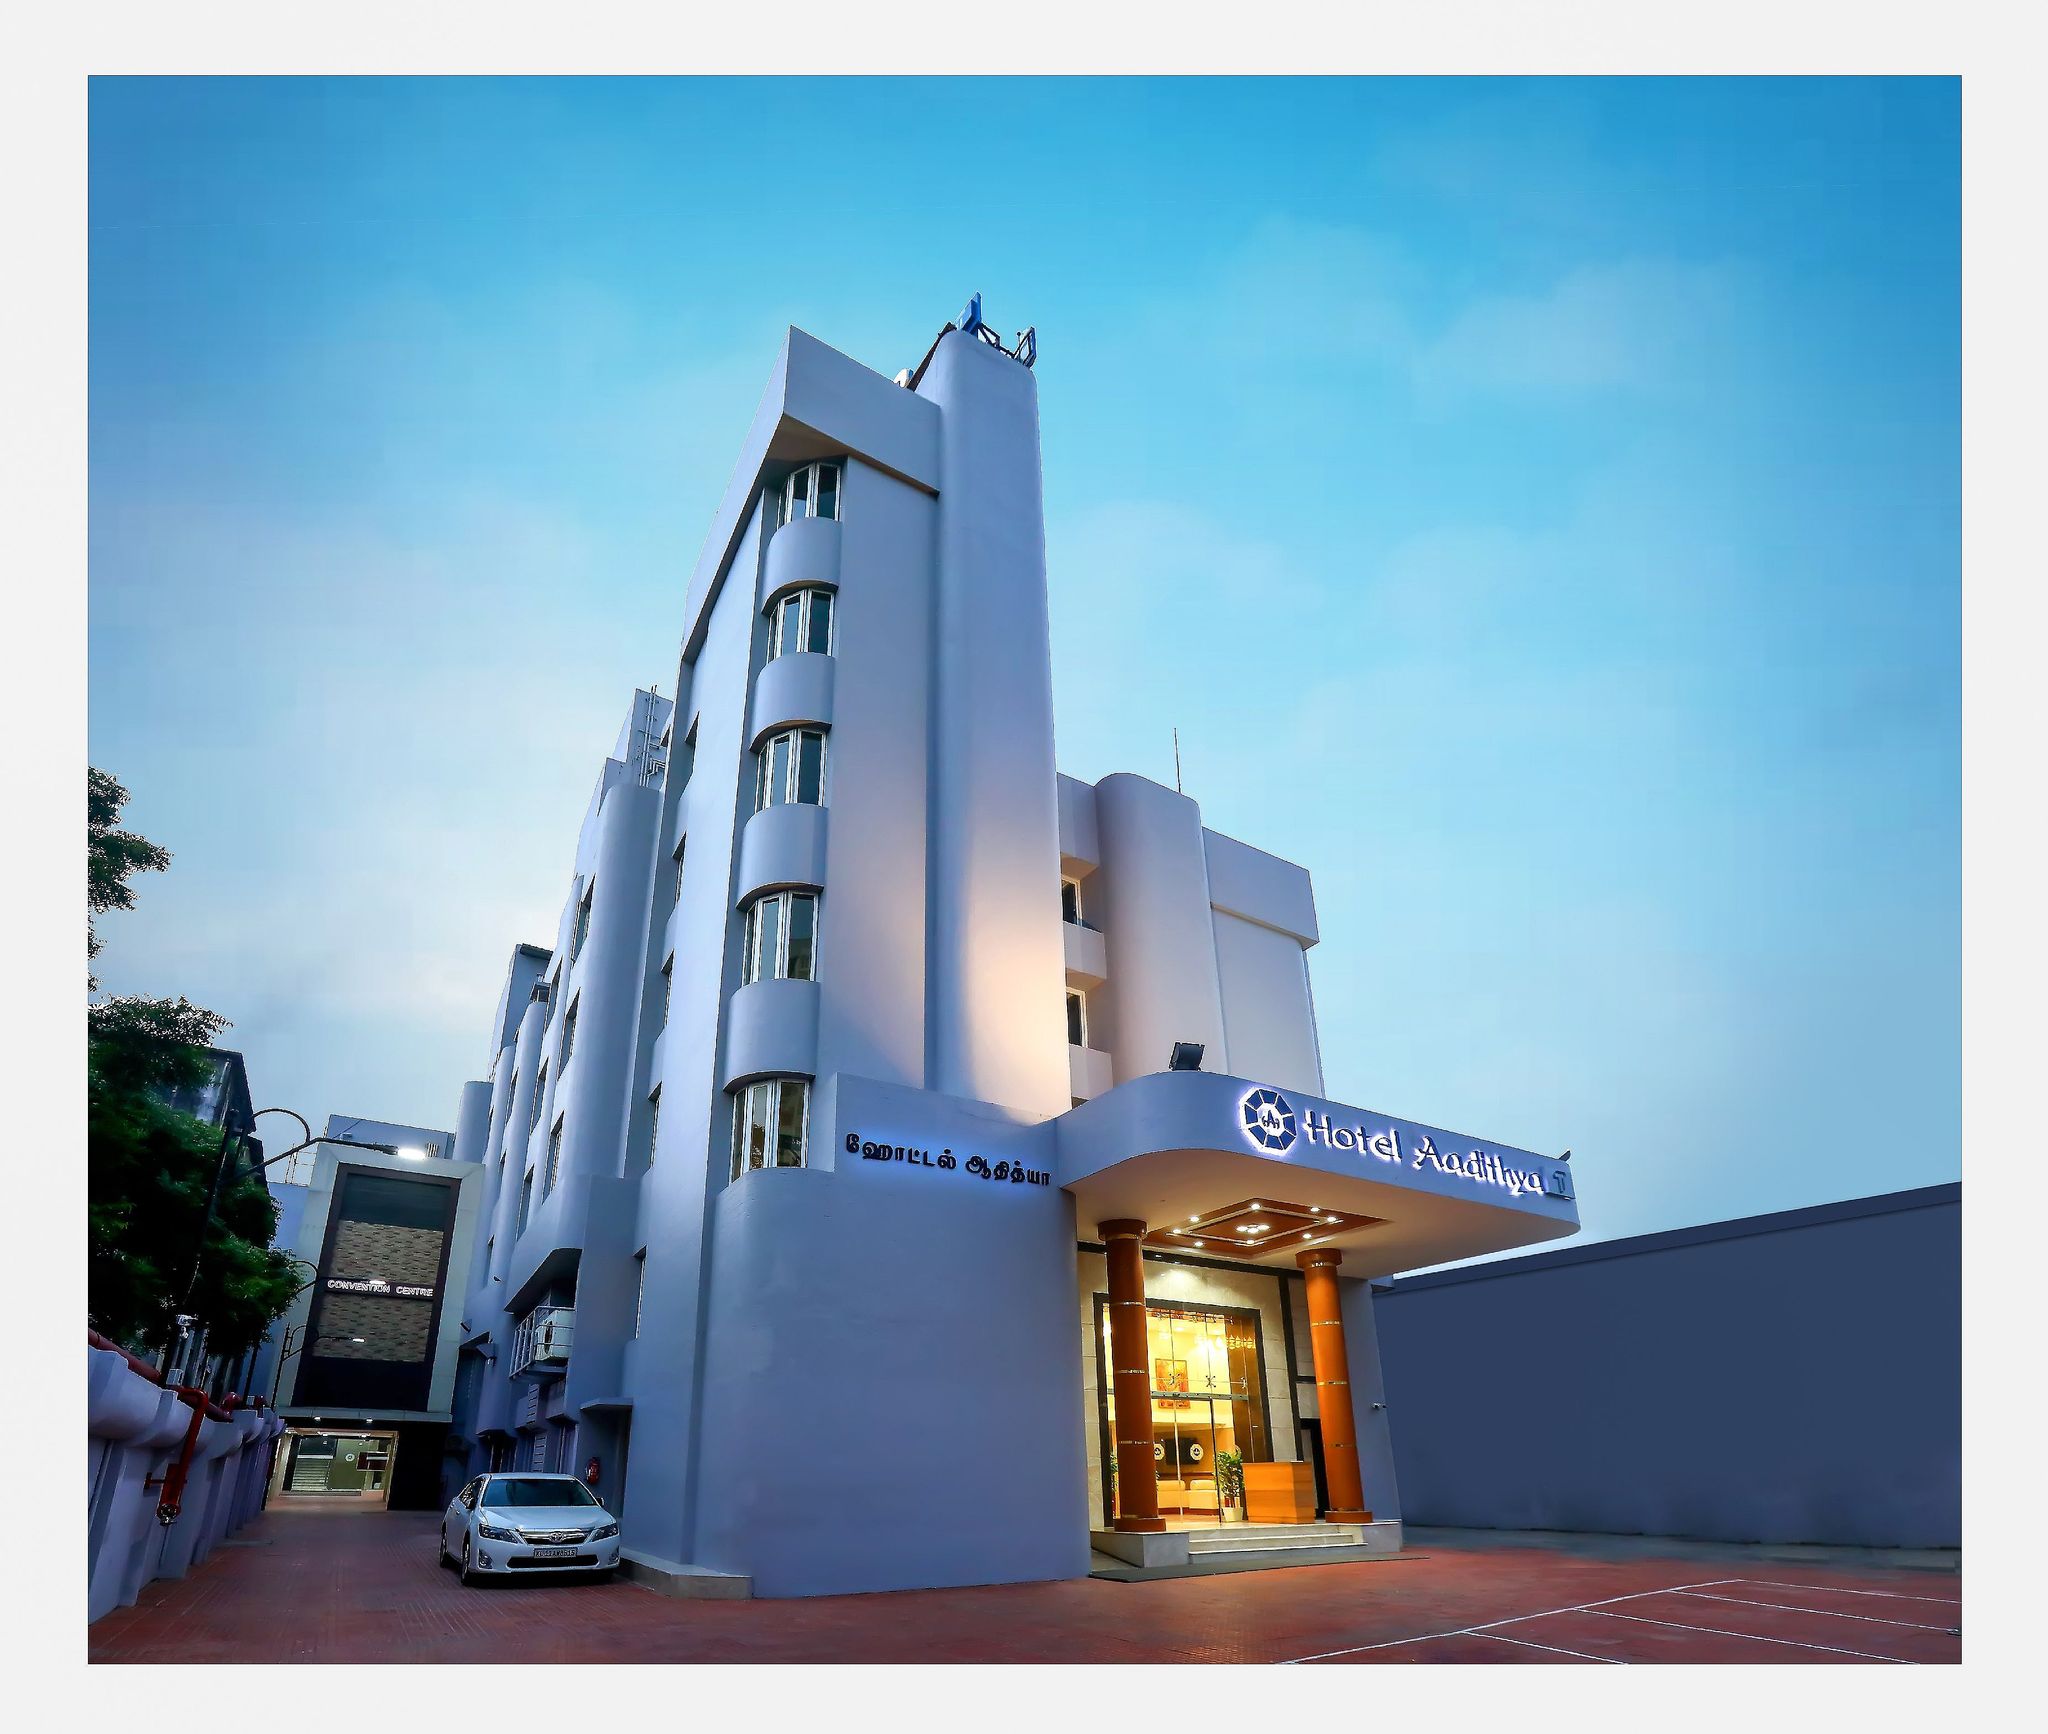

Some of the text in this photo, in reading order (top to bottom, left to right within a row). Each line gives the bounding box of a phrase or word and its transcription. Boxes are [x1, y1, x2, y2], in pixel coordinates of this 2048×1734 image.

[845, 1132, 1051, 1186] ஹோட்டல் ஆதித்யா
[1303, 1108, 1544, 1196] Hotel Aadithya
[327, 1279, 434, 1297] CONVENTION CENTRE
